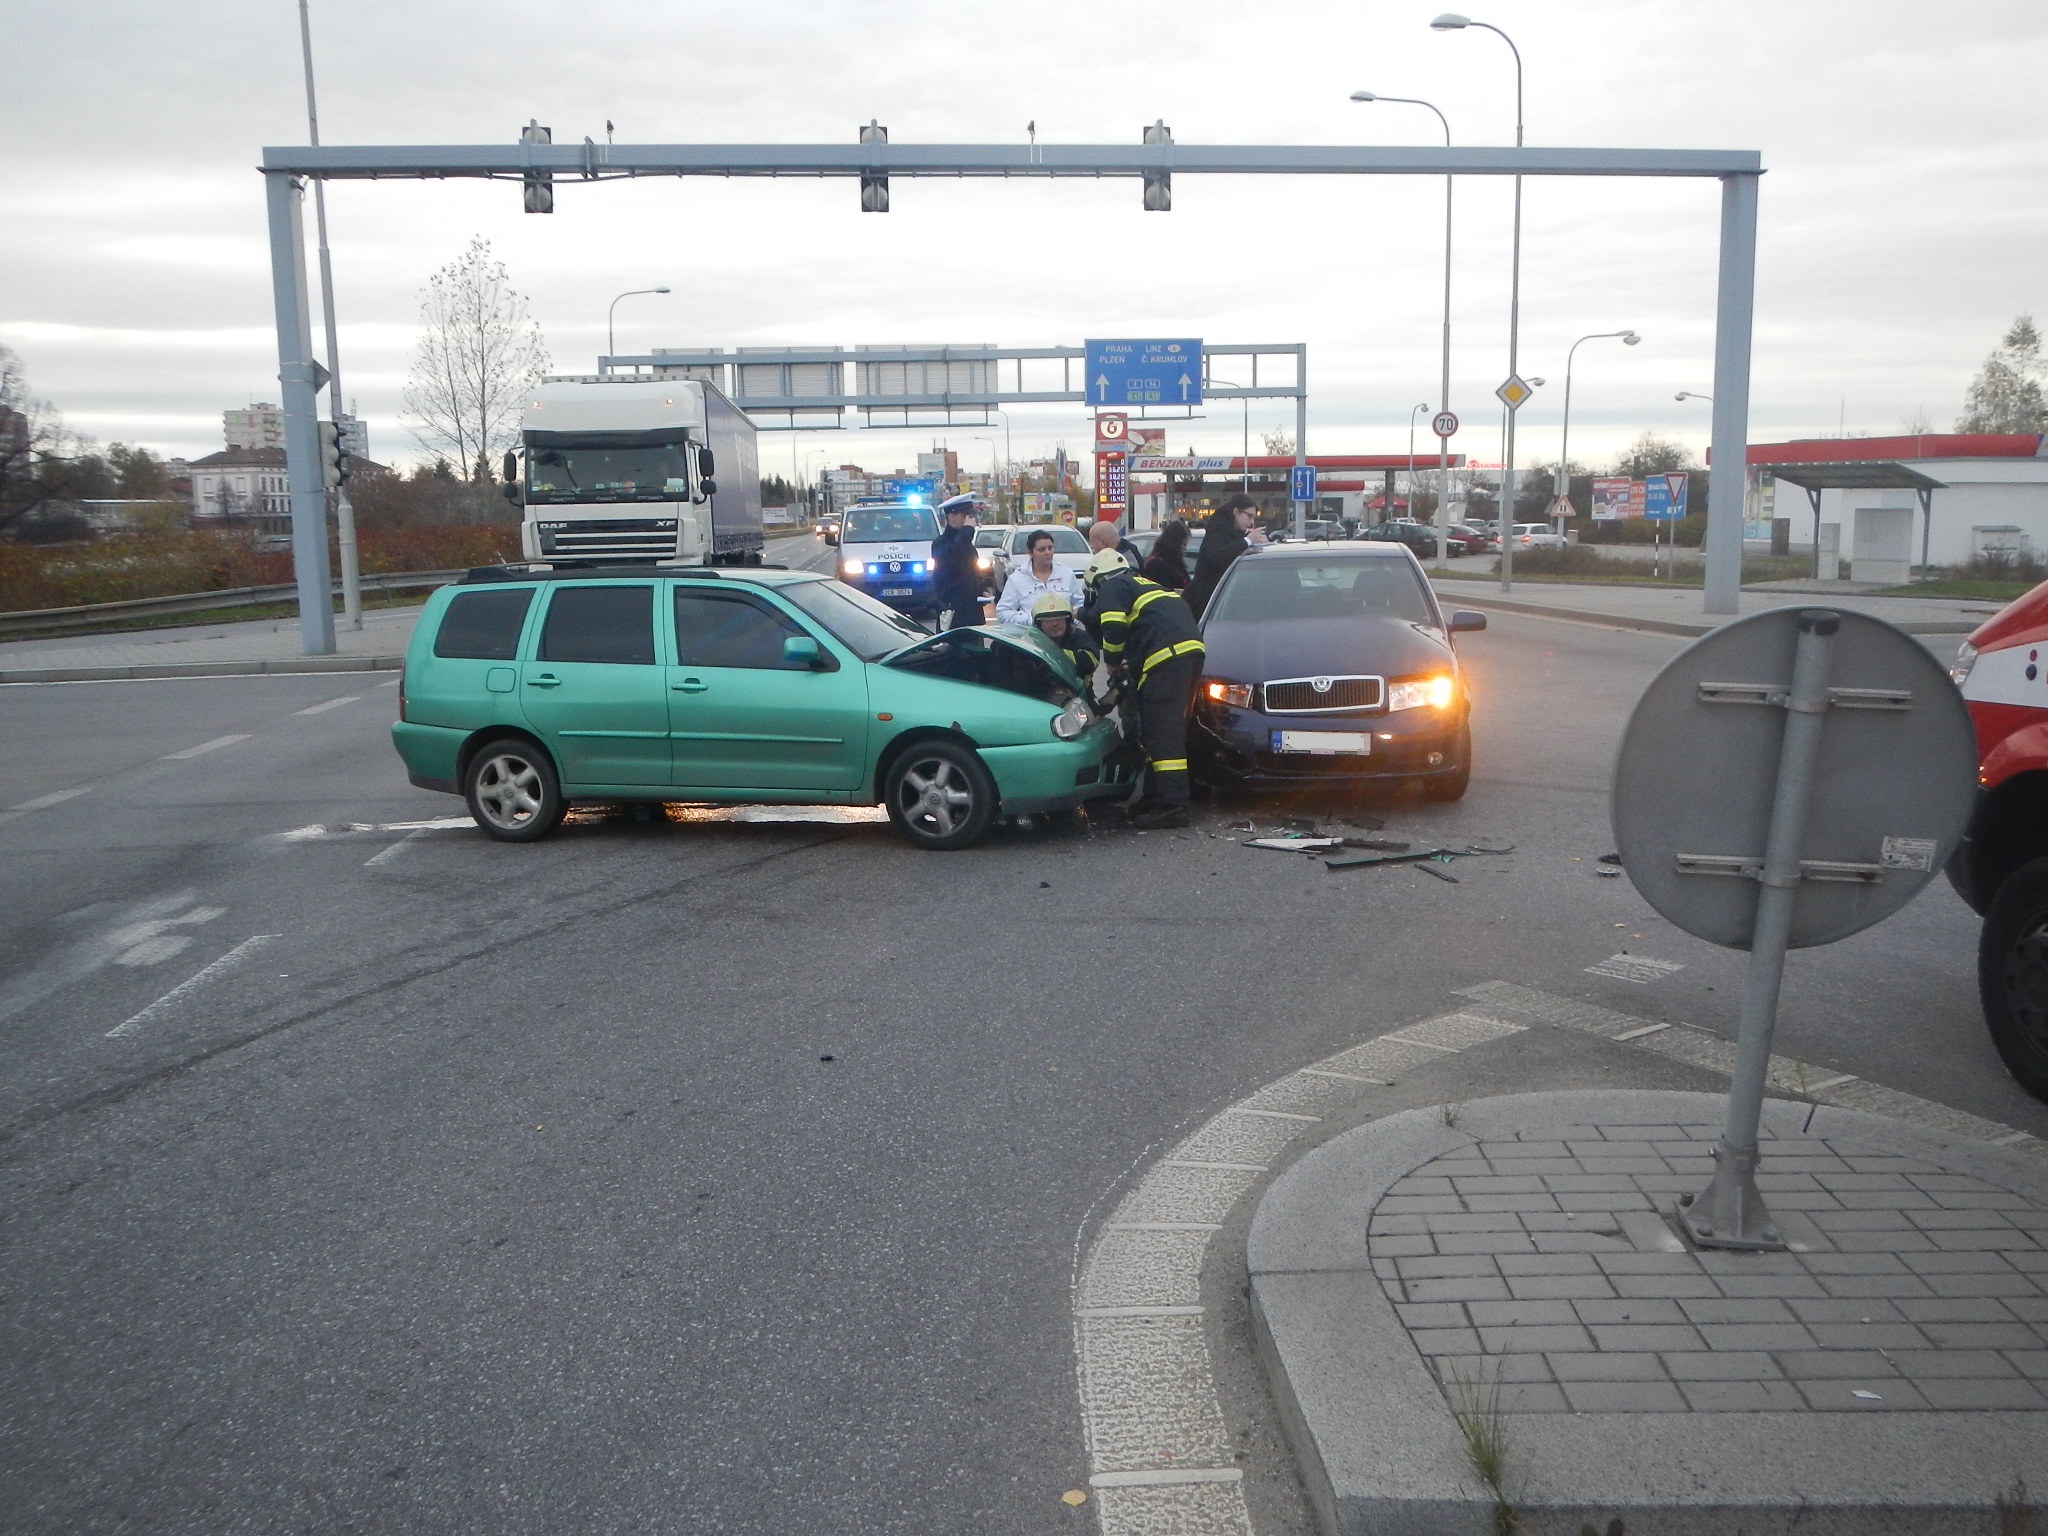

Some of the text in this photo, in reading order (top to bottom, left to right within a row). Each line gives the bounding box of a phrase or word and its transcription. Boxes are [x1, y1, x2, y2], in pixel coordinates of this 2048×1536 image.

[1105, 345, 1133, 353] PRAHA
[1145, 345, 1162, 353] LINZ
[1150, 355, 1188, 364] KRUMLOV
[1439, 418, 1454, 431] 70
[1140, 458, 1224, 470] BENZINA plus
